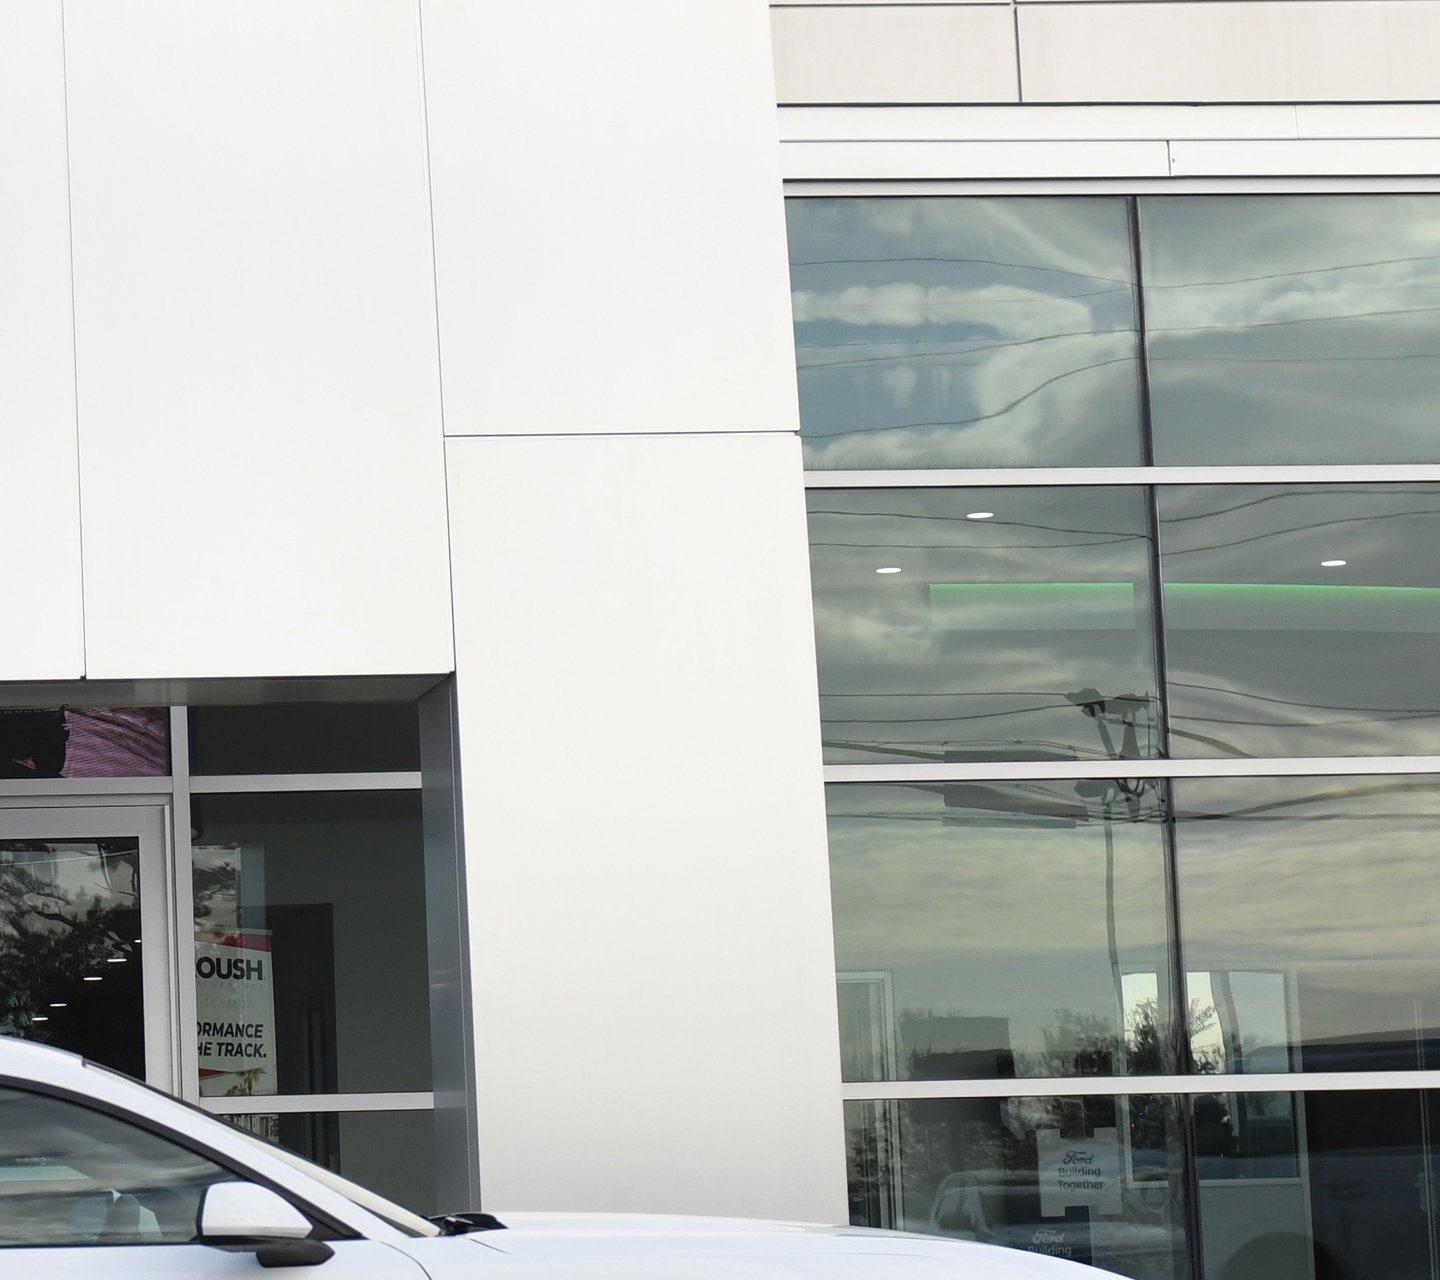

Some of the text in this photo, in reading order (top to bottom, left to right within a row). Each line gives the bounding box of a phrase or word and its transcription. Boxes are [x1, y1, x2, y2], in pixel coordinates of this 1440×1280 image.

[195, 956, 263, 981] OUSH
[197, 1022, 264, 1039] ORMANCE
[197, 1042, 268, 1058] HE TRACK.
[1063, 1150, 1095, 1165] Ford
[1058, 1167, 1101, 1179] Building
[1057, 1180, 1104, 1192] Together
[1032, 1229, 1065, 1244] Ford
